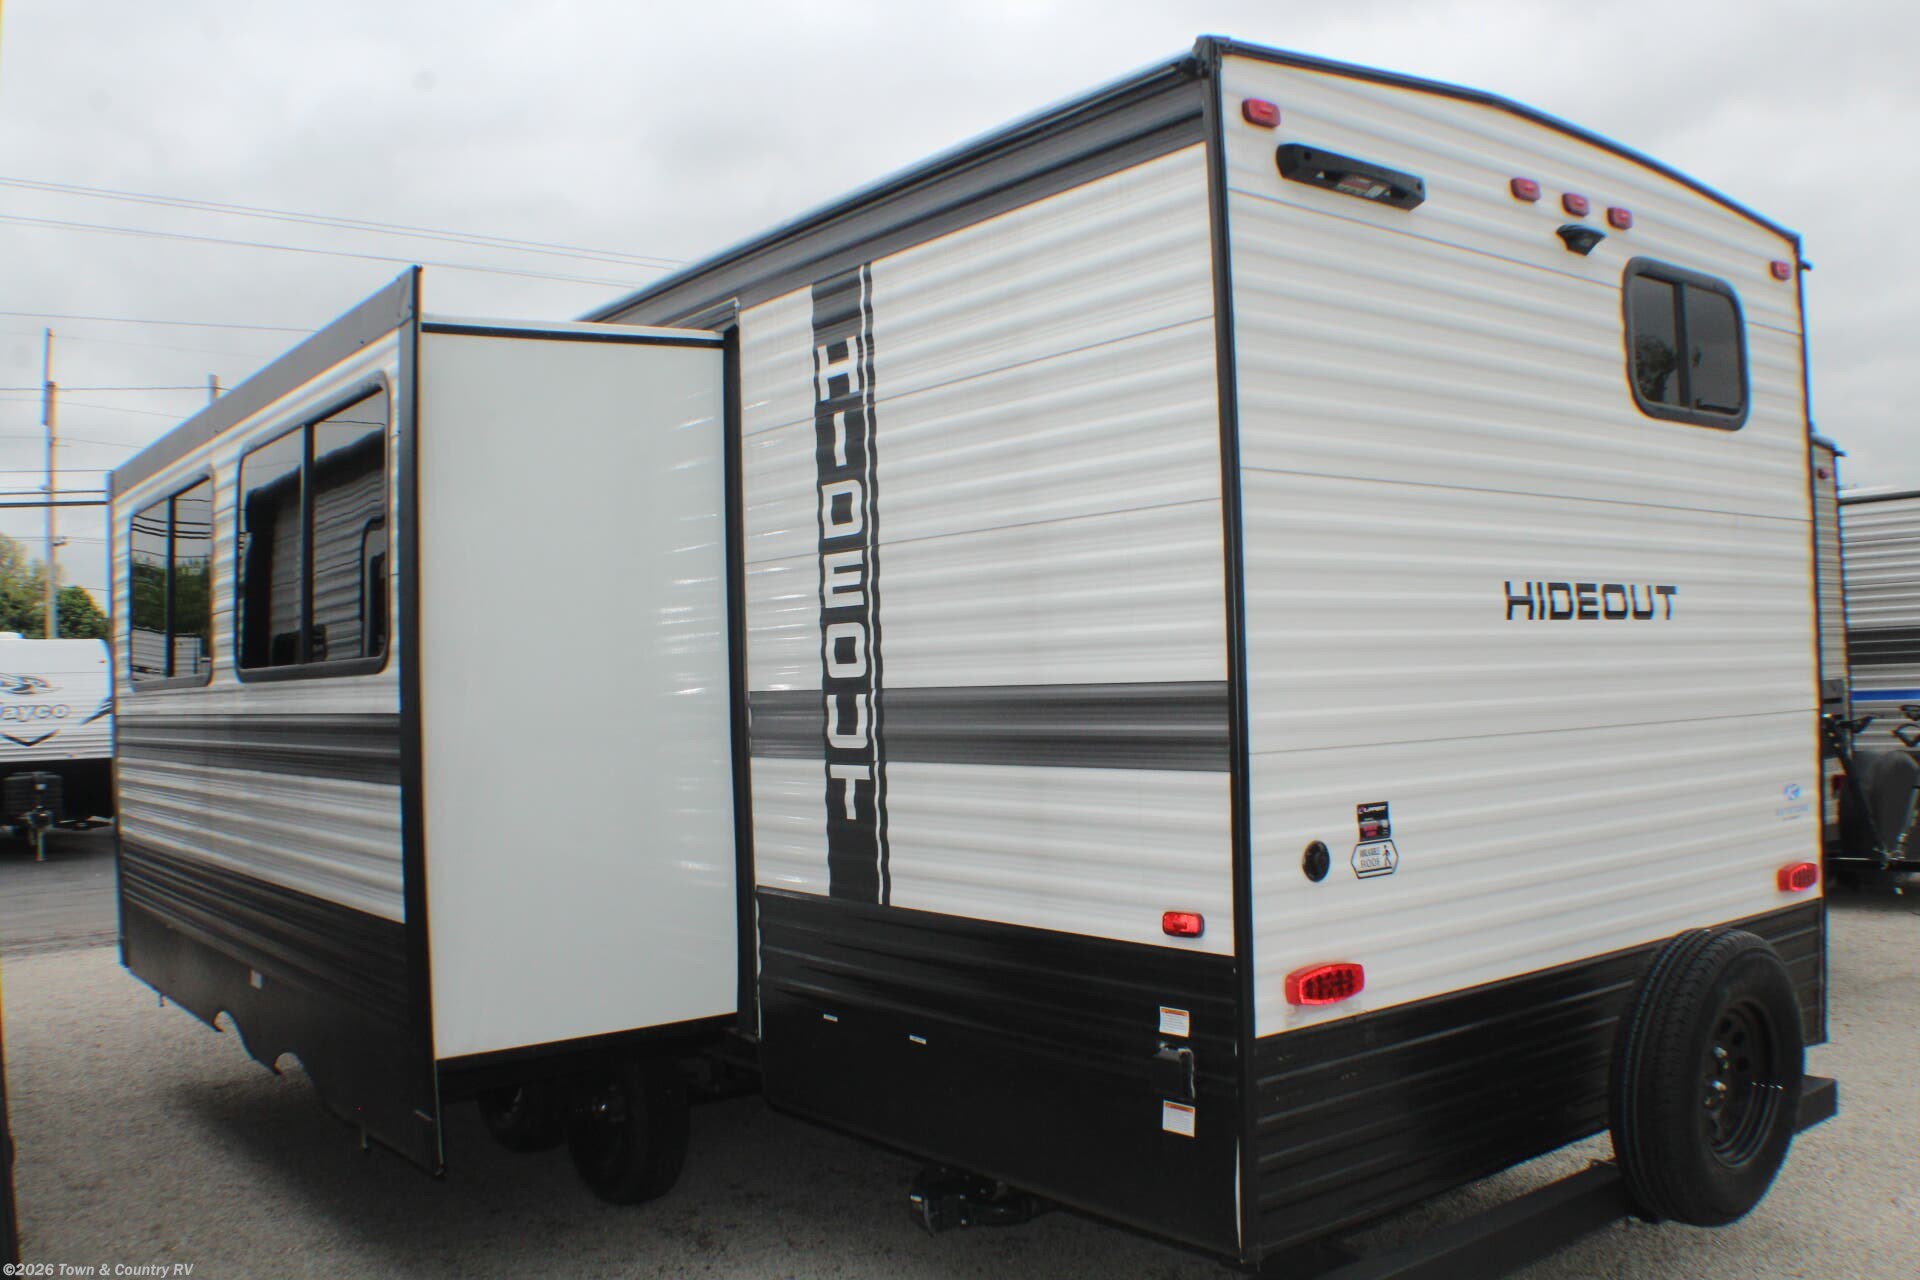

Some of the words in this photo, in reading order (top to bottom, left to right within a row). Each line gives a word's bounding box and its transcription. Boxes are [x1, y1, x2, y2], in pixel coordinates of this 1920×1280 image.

[817, 335, 871, 820] HIDEOUT
[1504, 581, 1678, 620] HIDEOUT
[0, 702, 70, 723] ayco
